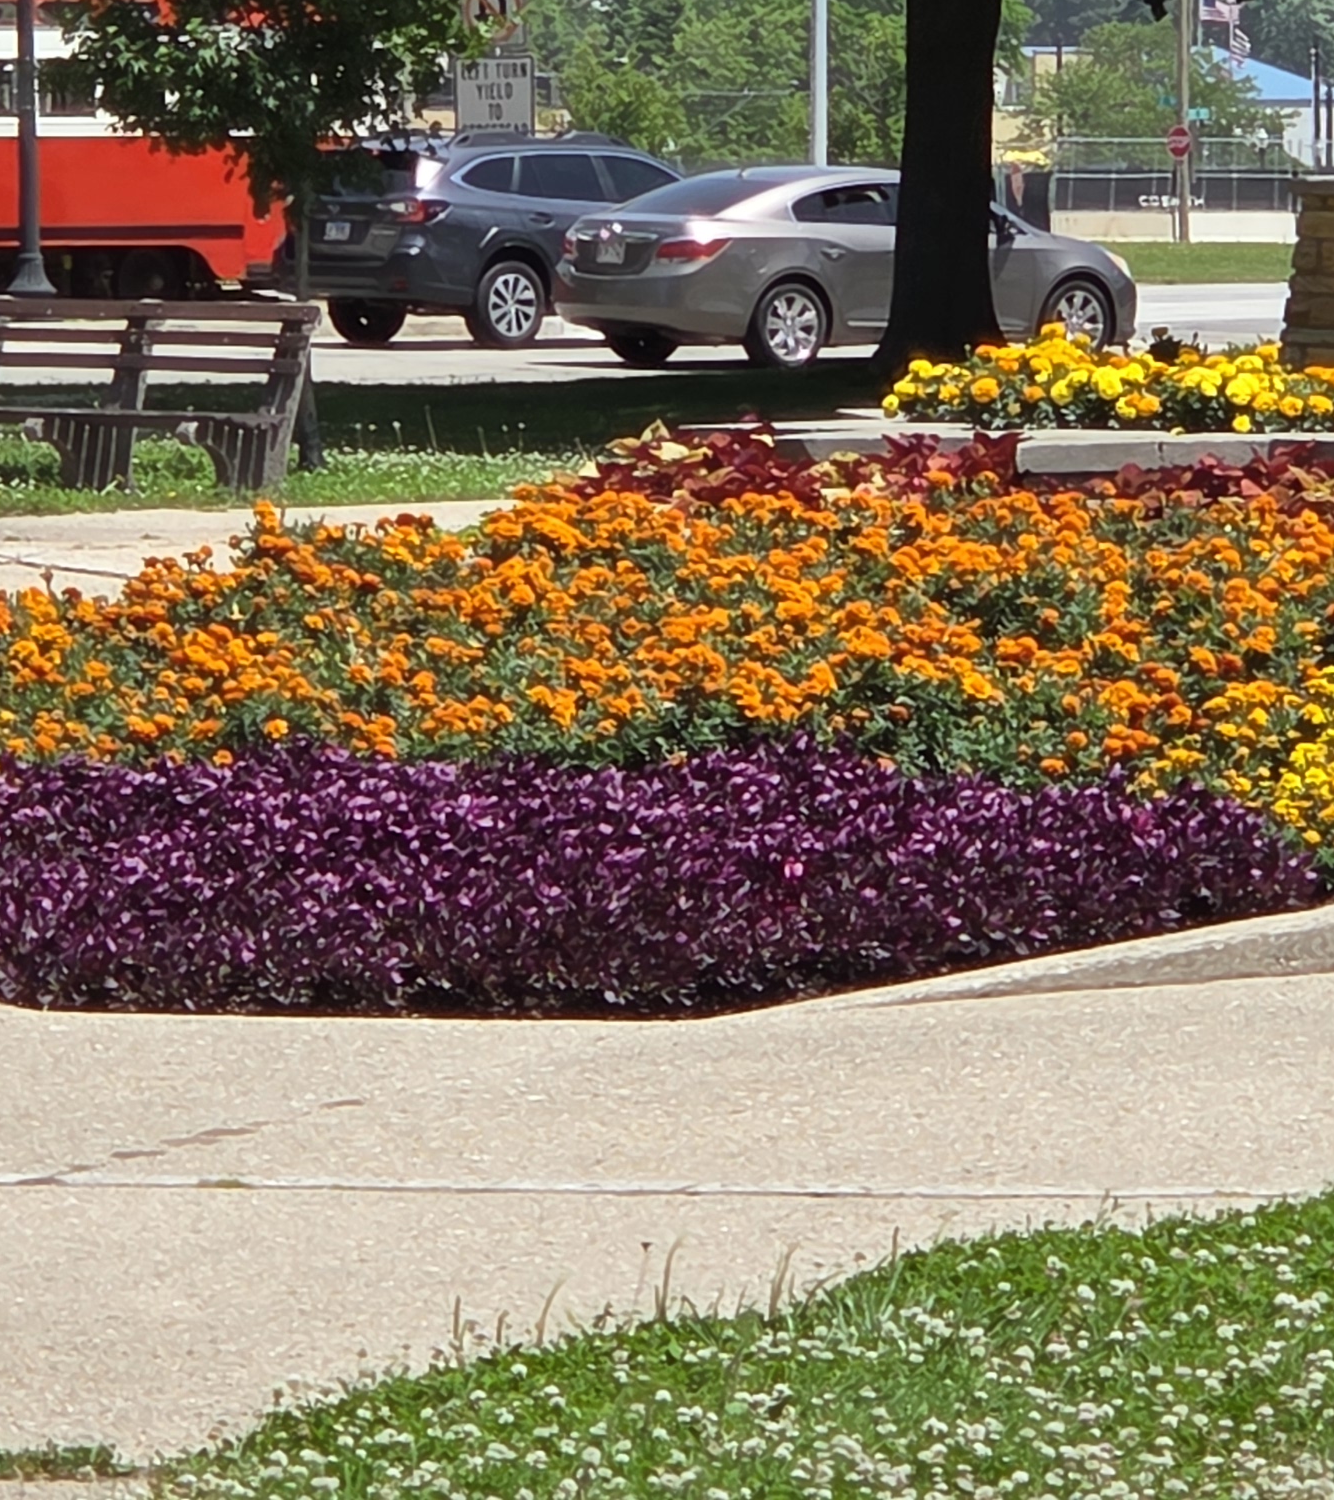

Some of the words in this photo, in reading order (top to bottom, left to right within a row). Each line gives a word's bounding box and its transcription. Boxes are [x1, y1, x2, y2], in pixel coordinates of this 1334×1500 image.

[496, 62, 527, 79] TURN
[476, 82, 513, 100] YIELD
[488, 102, 503, 121] TO
